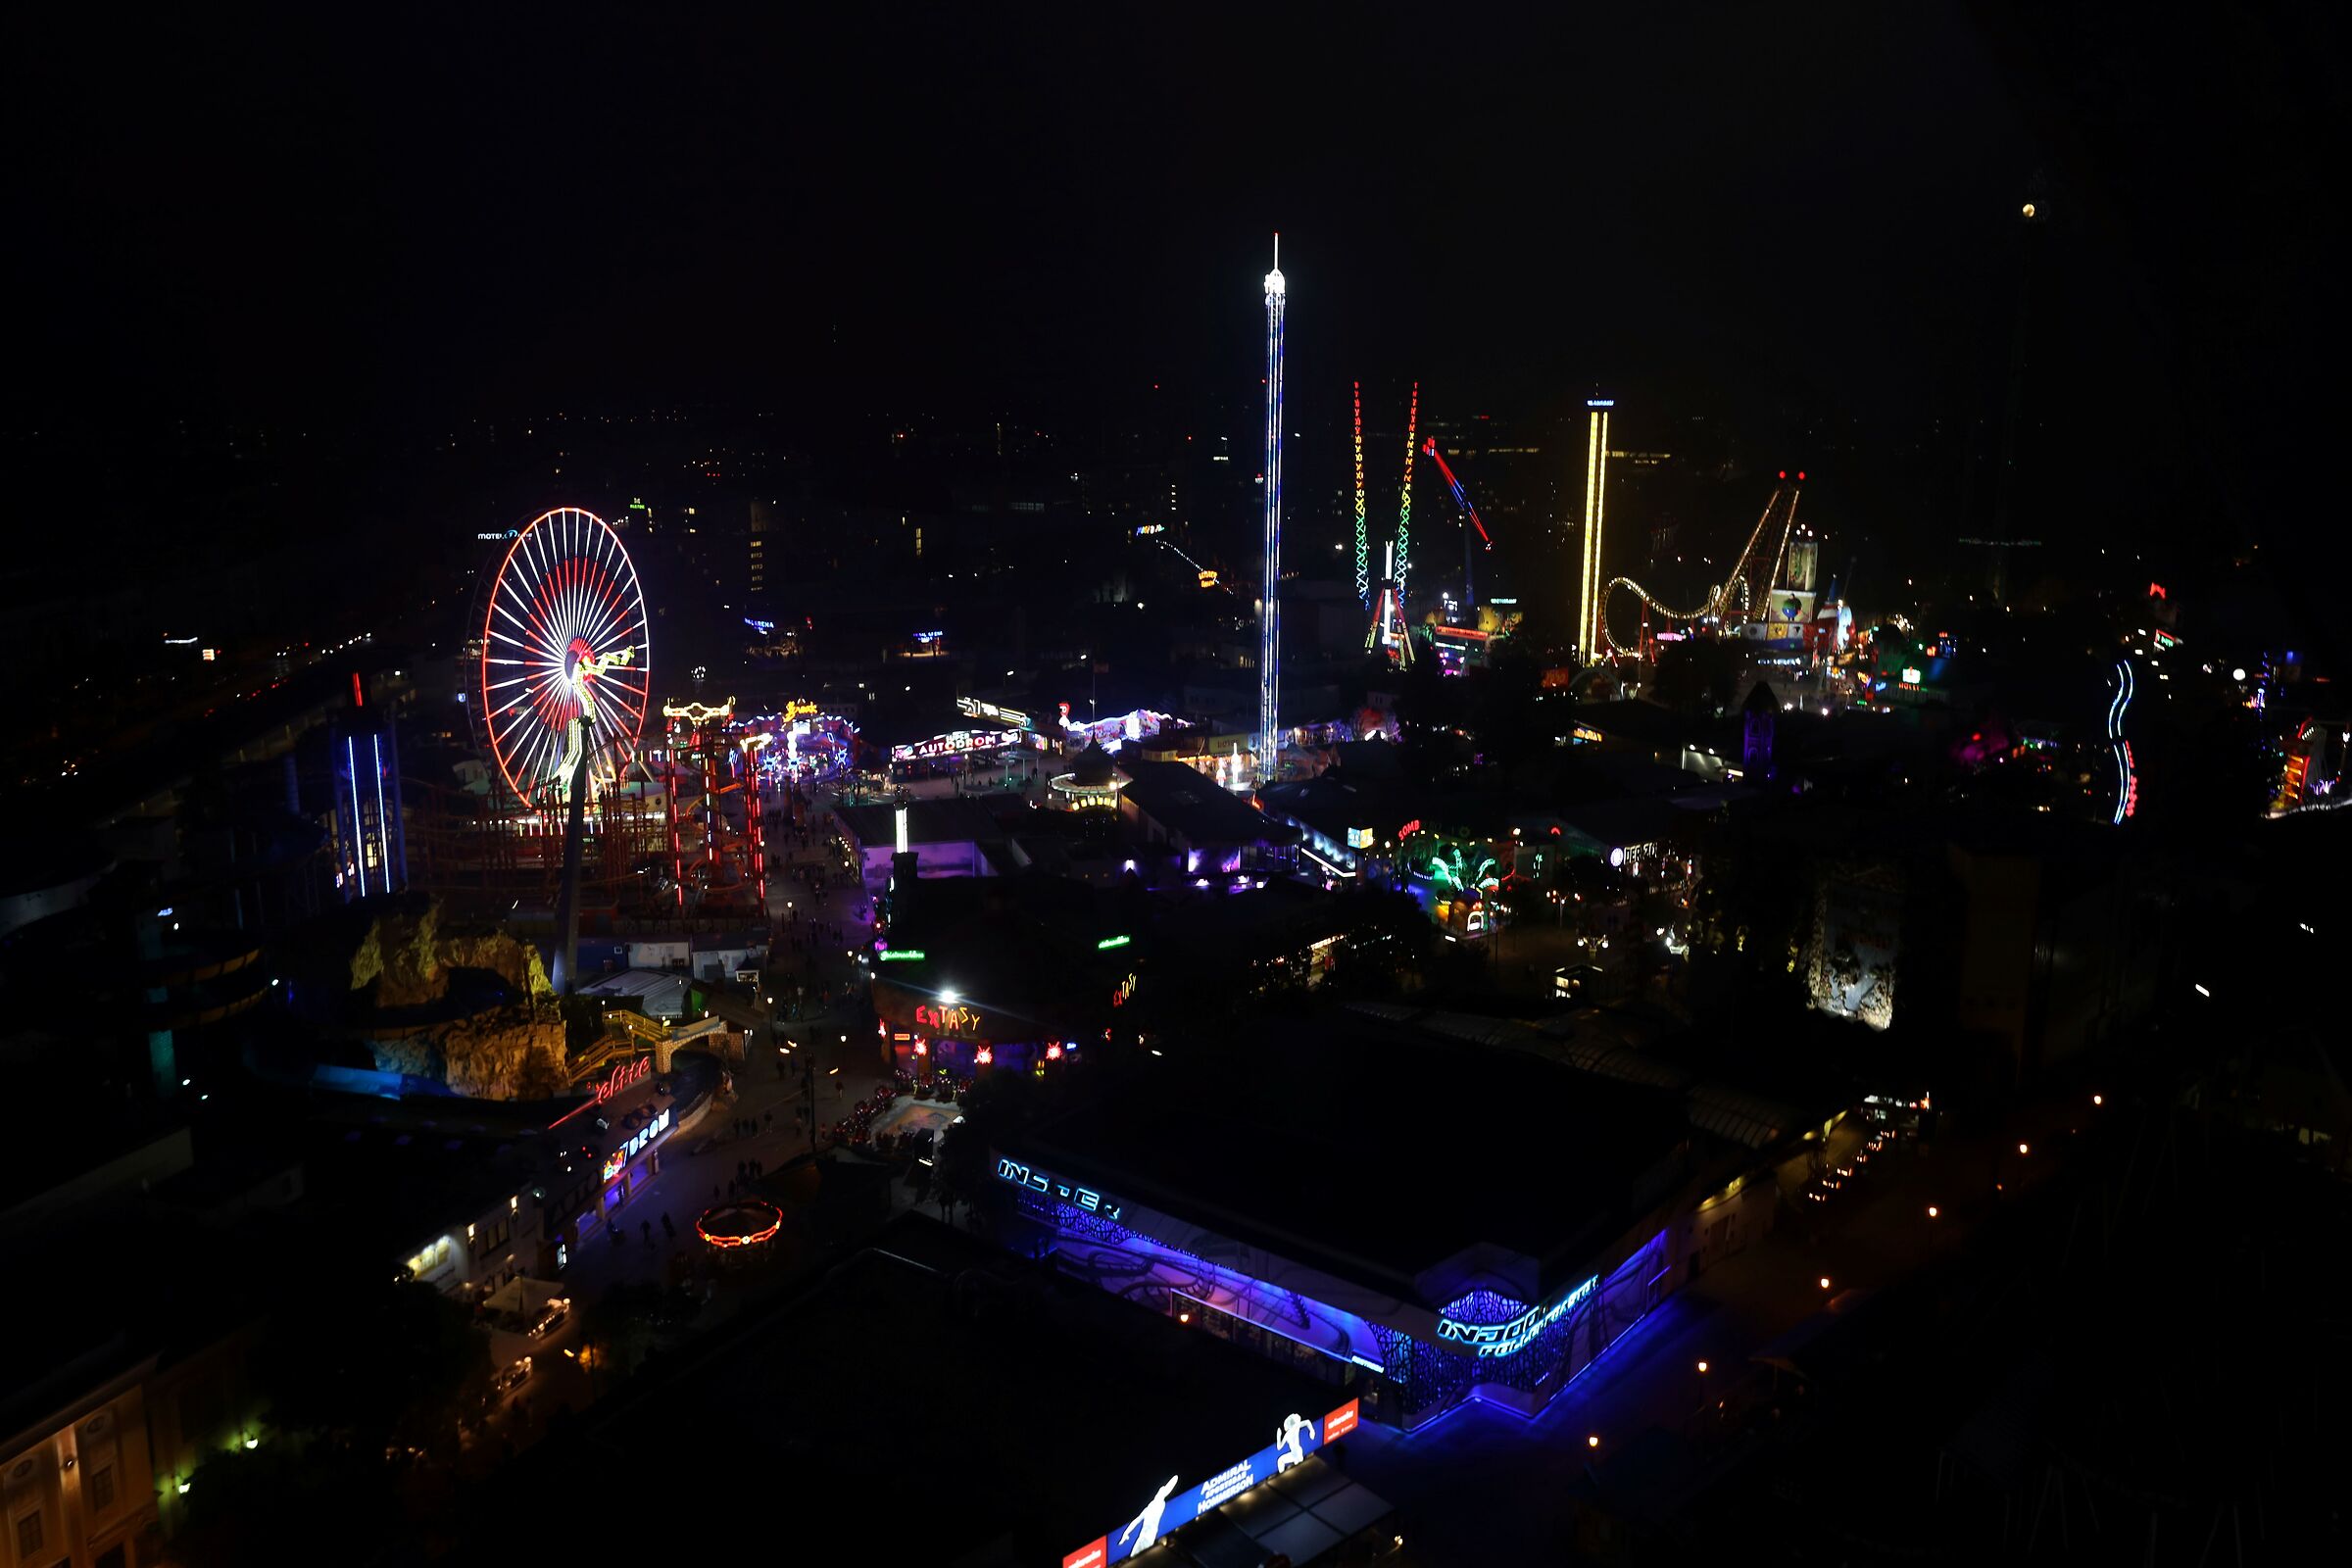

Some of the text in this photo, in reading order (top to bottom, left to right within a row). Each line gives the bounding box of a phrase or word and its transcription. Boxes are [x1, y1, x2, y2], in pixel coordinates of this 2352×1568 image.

[919, 735, 996, 755] AUTODROM
[1113, 973, 1137, 1008] EXTASY
[915, 1004, 981, 1032] EXTASY
[1200, 1459, 1252, 1495] ADMIRAL
